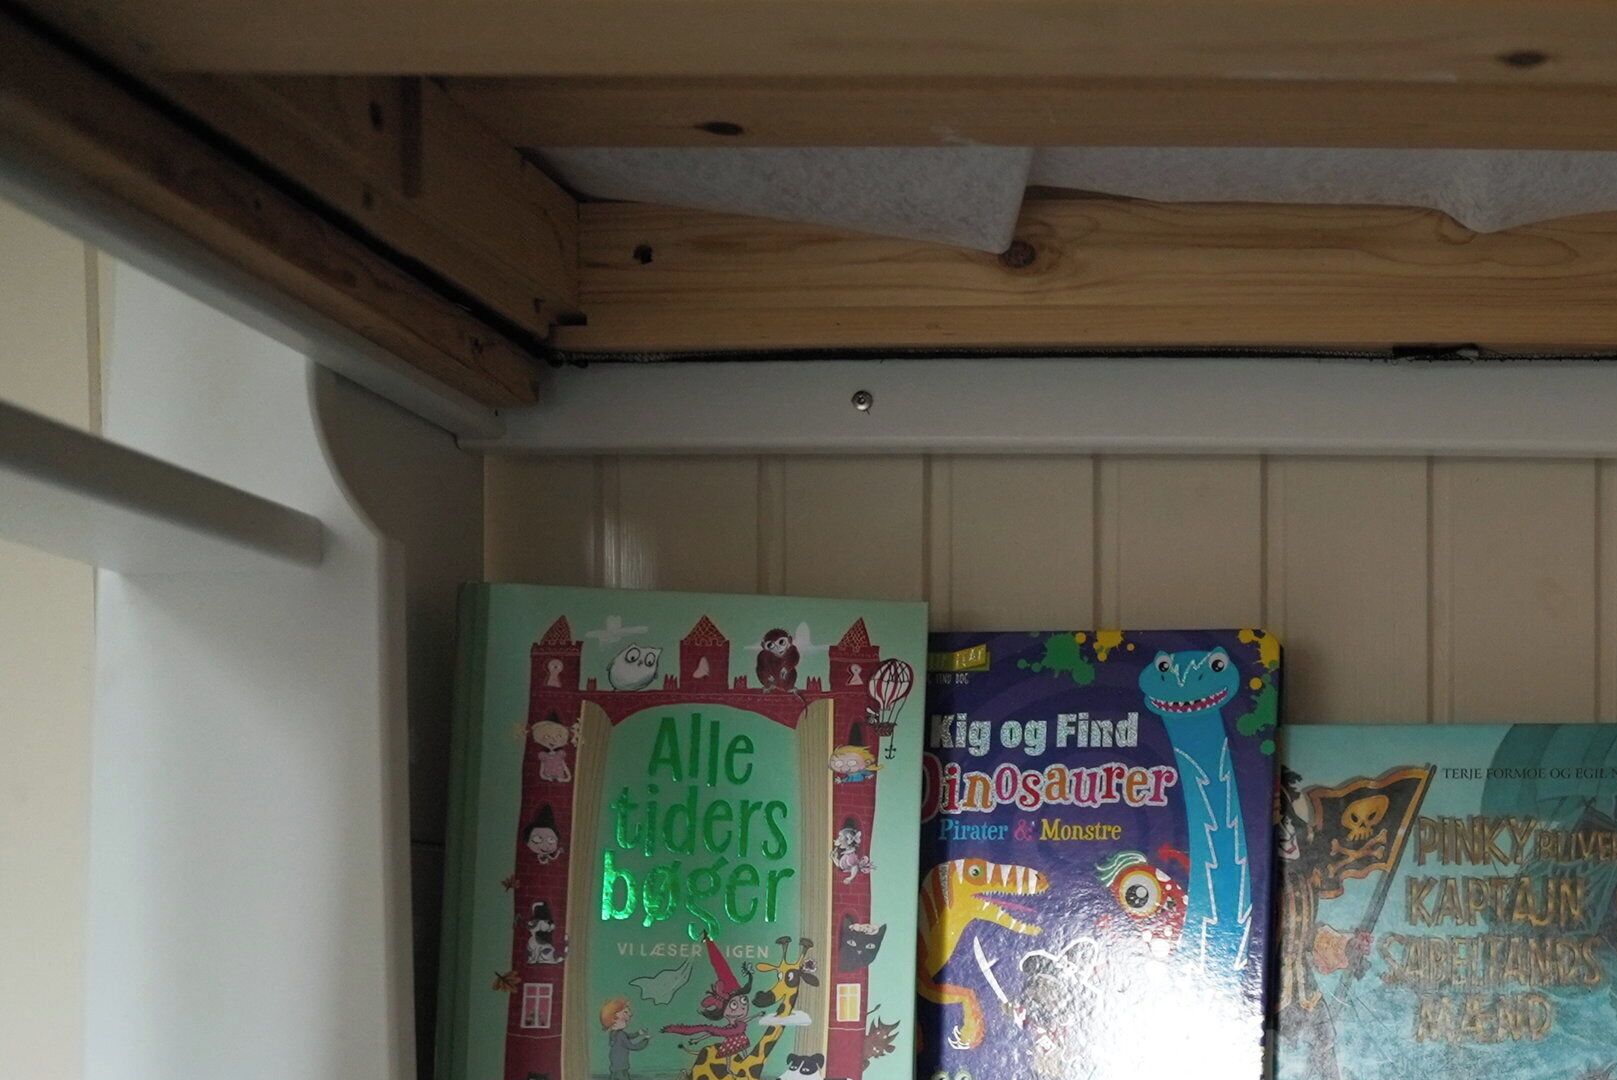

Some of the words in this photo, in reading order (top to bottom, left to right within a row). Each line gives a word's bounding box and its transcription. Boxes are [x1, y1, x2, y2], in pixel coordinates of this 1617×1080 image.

[648, 713, 754, 788] Alle
[930, 712, 992, 756] Kig
[1000, 720, 1048, 756] og
[1056, 712, 1139, 748] Find
[1443, 767, 1483, 781] TERJE
[1486, 767, 1546, 780] FORMOE
[1549, 767, 1571, 780] OG
[1575, 767, 1608, 780] EGIL
[609, 784, 788, 861] tiders
[938, 819, 1009, 841] Pirater
[1013, 819, 1034, 841] &
[1039, 818, 1122, 841] Monstre
[1413, 815, 1538, 867] PINKY
[601, 850, 796, 943] bøger
[1405, 873, 1590, 929] KAPTAJN
[617, 942, 634, 956] VI
[640, 943, 702, 958] LÆSER
[726, 944, 770, 959] IGEN
[1379, 932, 1607, 988] SABELTANDS
[1415, 992, 1554, 1044] MÆND
